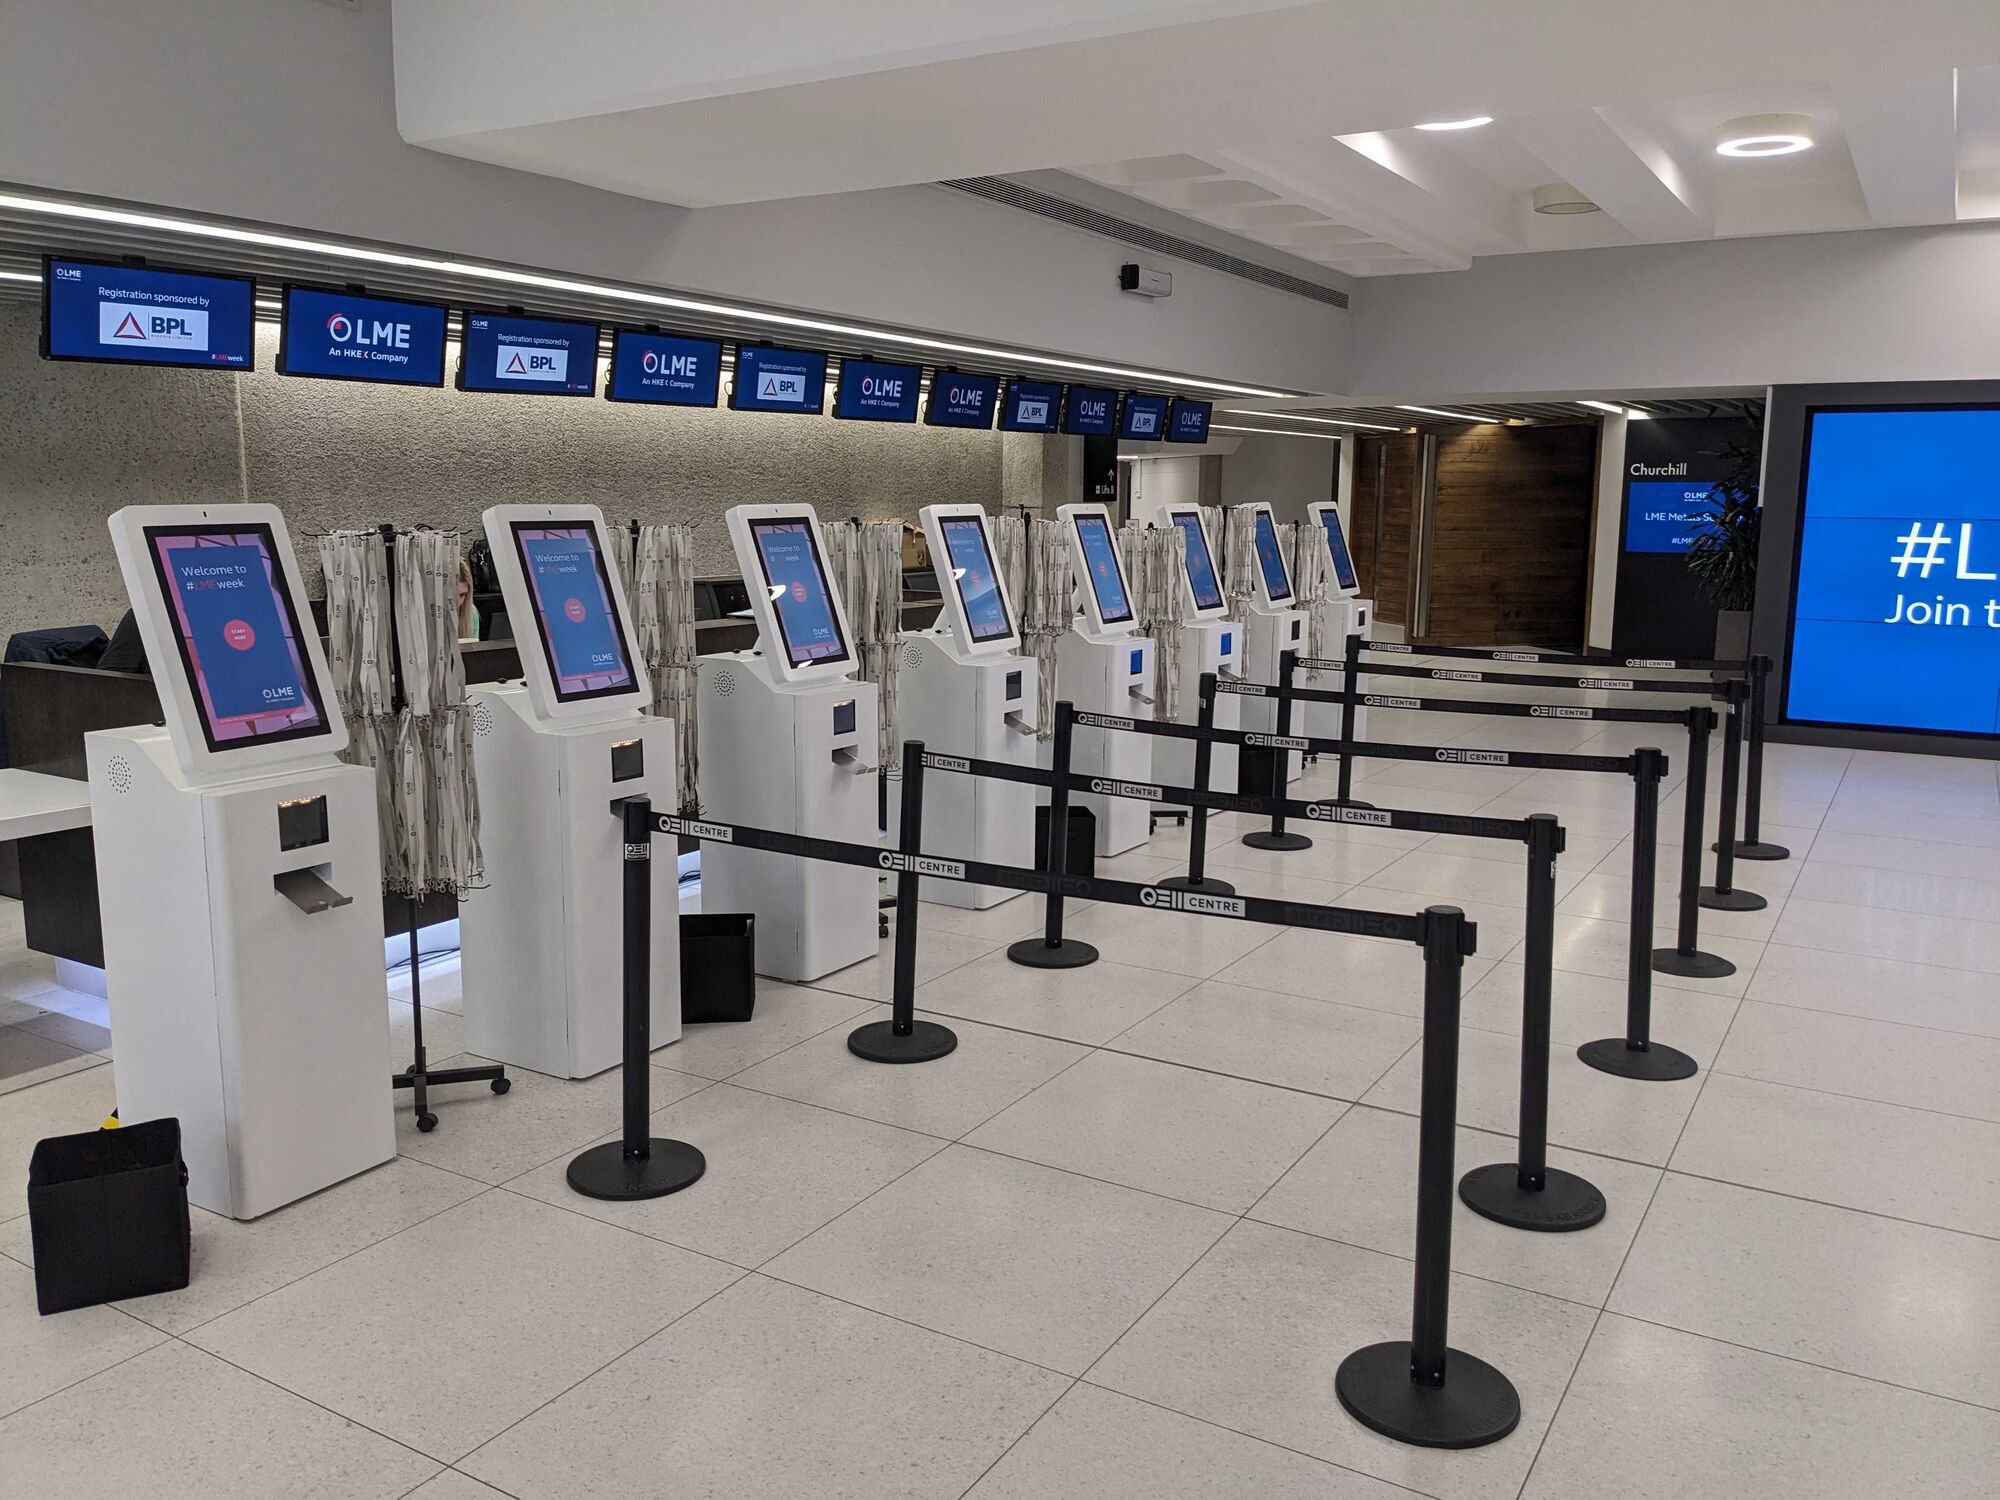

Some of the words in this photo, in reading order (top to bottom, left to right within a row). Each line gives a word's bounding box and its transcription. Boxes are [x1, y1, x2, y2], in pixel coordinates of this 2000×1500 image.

[98, 286, 152, 300] Registration
[153, 292, 198, 305] sponsored
[199, 296, 210, 307] by
[151, 316, 193, 336] BPL
[498, 333, 533, 344] Registration
[533, 337, 562, 346] sponsored
[562, 339, 570, 348] by
[328, 347, 341, 357] An
[371, 351, 409, 365] Company
[529, 355, 557, 371] BPL
[669, 380, 695, 390] Company
[779, 380, 798, 393] BPL
[1031, 406, 1043, 417] BPL
[1630, 462, 1687, 476] Churchill
[1645, 512, 1666, 521] LME
[534, 554, 570, 562] Welcome
[571, 553, 579, 561] to
[181, 566, 233, 577] Welcome
[235, 565, 247, 574] to
[538, 565, 578, 573] #week
[1884, 593, 1970, 627] Join
[1238, 686, 1264, 694] CENTRE
[1390, 699, 1417, 707] CENTRE
[1104, 718, 1131, 728] CENTRE
[1274, 739, 1305, 748] CENTRE
[920, 752, 934, 768] EII
[937, 759, 967, 769] CENTRE
[1469, 753, 1505, 762] CENTRE
[1124, 785, 1158, 797] CENTRE
[1345, 811, 1387, 823] CENTRE
[693, 825, 728, 838] CENTRE
[919, 861, 960, 875] CENTRE
[1189, 897, 1239, 912] CENTRE
